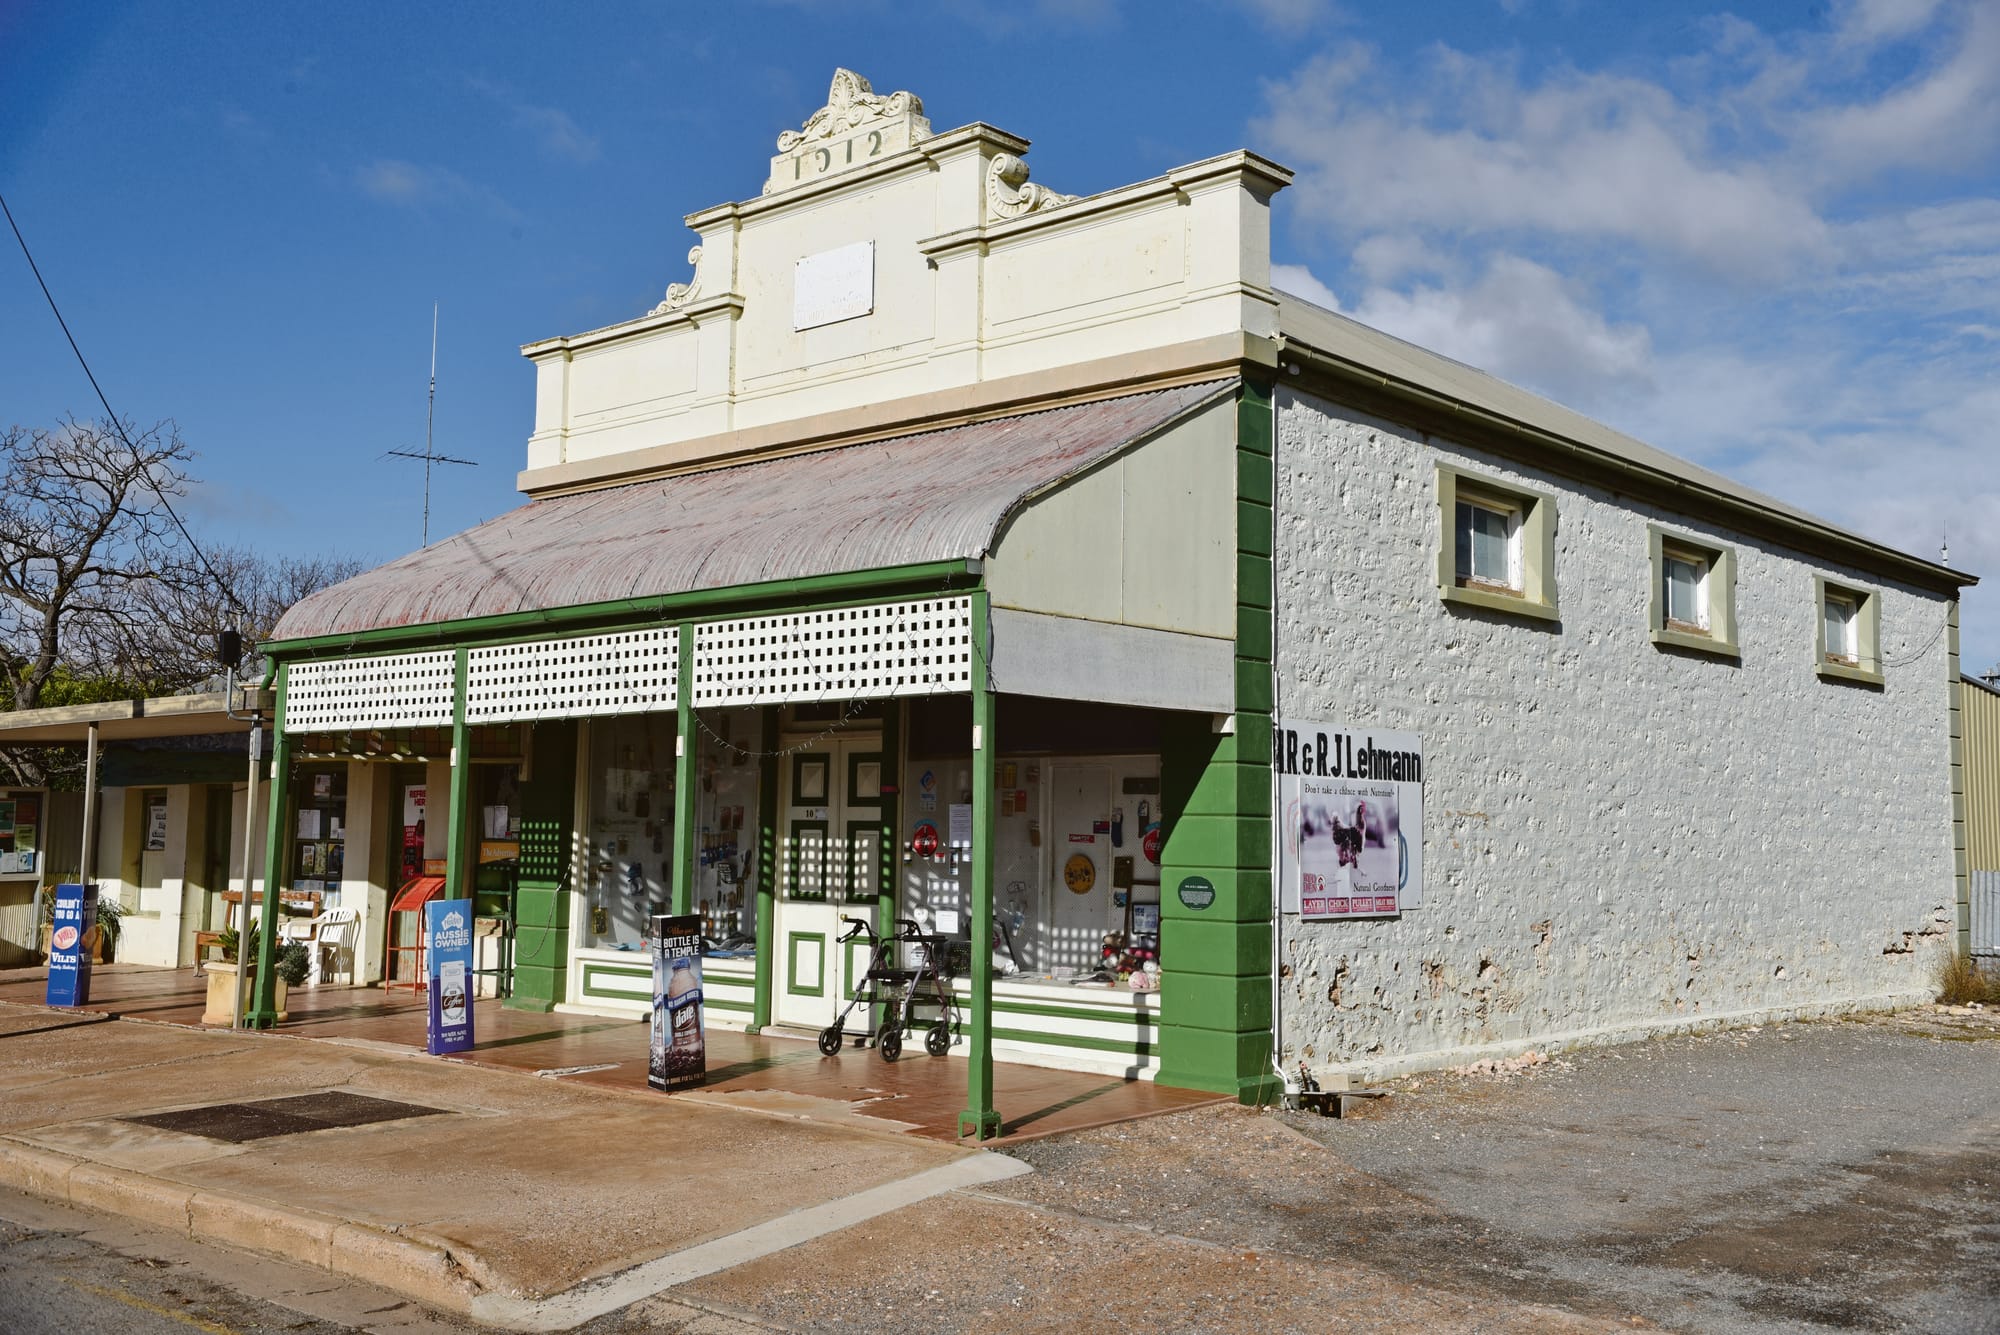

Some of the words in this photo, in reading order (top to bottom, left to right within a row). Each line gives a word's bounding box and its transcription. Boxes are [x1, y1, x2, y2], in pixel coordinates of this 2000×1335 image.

[1346, 734, 1422, 783] Lehmann
[75, 910, 80, 920] A
[435, 928, 470, 940] AUSSIE
[434, 938, 470, 949] OWNED
[663, 936, 691, 948] BOTTLE
[693, 934, 700, 945] IS
[664, 948, 670, 959] A
[671, 945, 700, 958] TEMPLE
